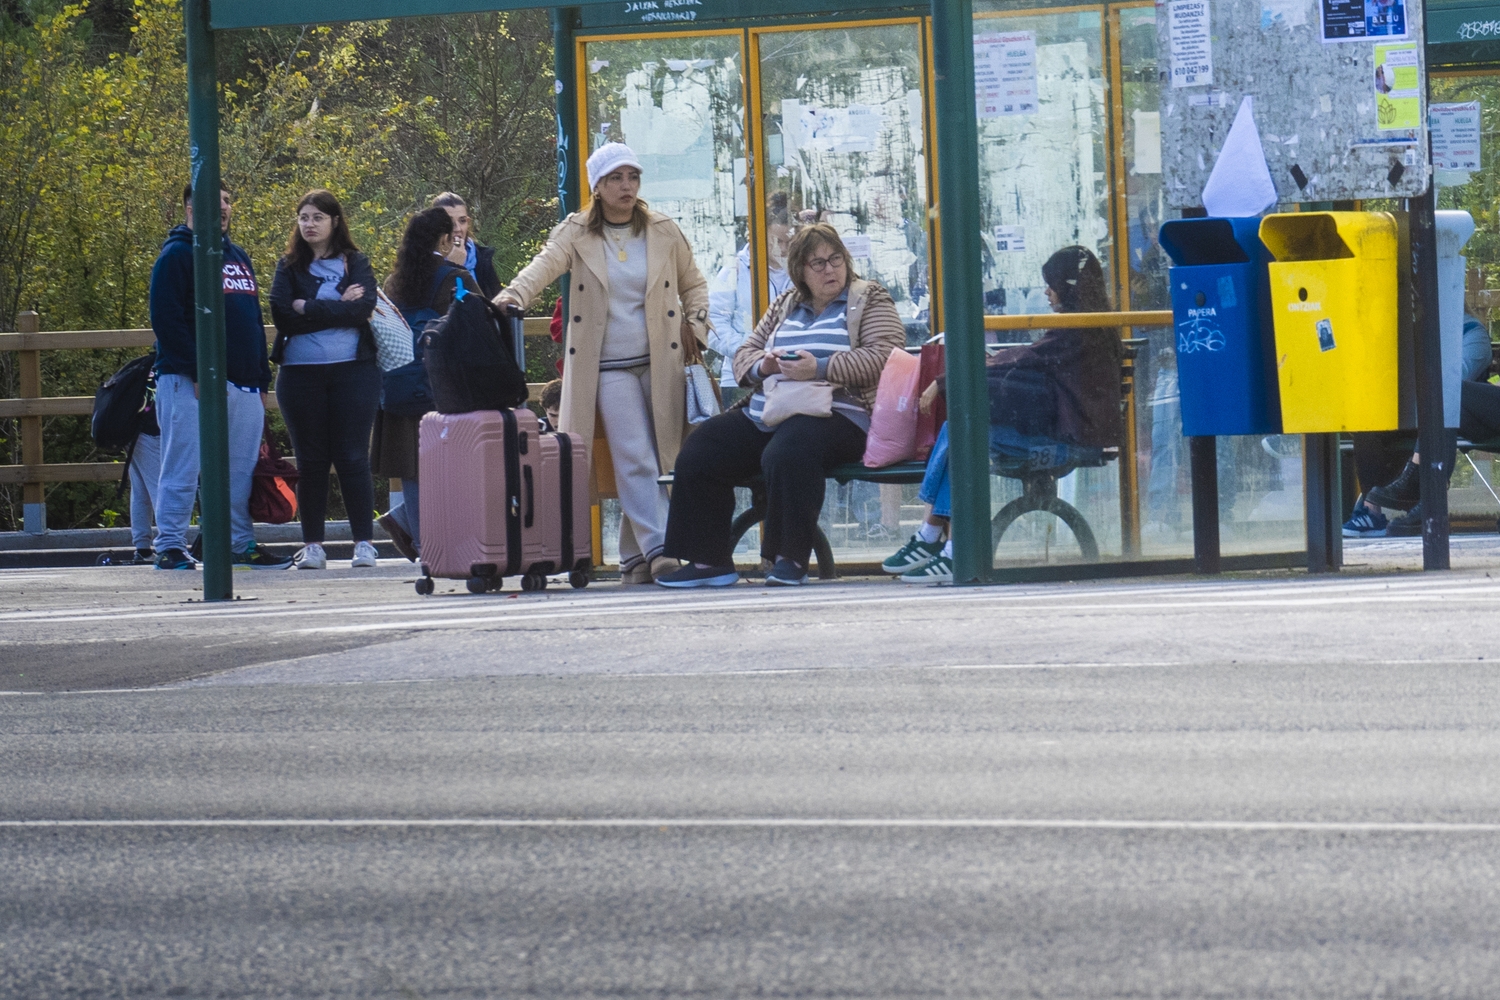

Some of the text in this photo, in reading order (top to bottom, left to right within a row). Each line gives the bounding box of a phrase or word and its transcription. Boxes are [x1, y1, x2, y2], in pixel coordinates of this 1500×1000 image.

[1174, 10, 1204, 19] MUDANZAS
[1175, 67, 1186, 76] 610
[1187, 308, 1217, 317] PAPERA
